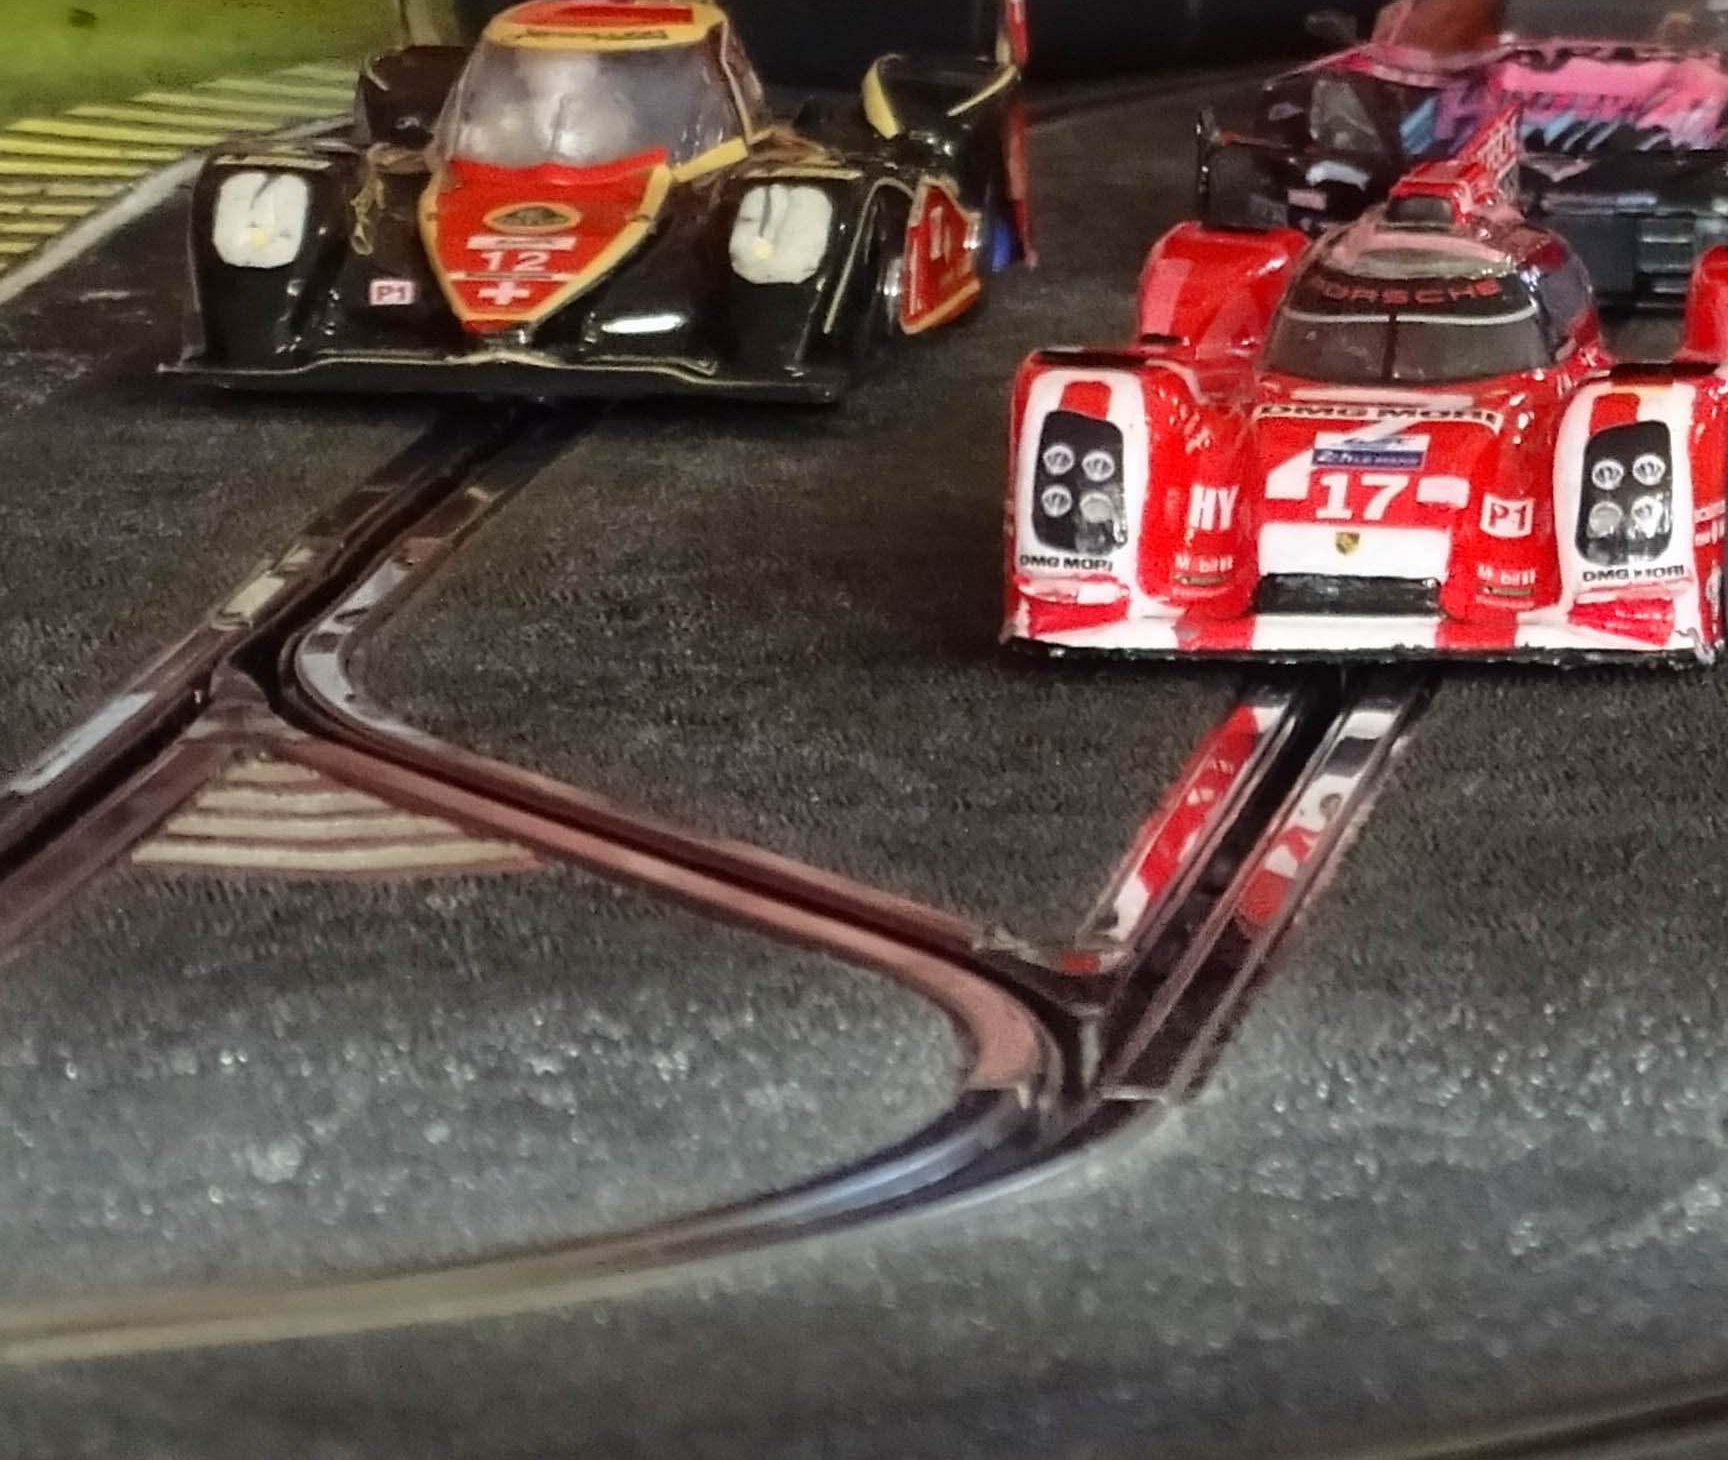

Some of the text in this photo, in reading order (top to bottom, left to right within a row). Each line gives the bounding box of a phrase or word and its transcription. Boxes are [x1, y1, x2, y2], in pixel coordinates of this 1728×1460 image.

[480, 250, 550, 272] 12
[1189, 486, 1239, 530] HY
[1316, 474, 1408, 520] 17
[1489, 502, 1526, 531] P1
[1020, 555, 1059, 568] DMG
[1583, 569, 1629, 582] DMG
